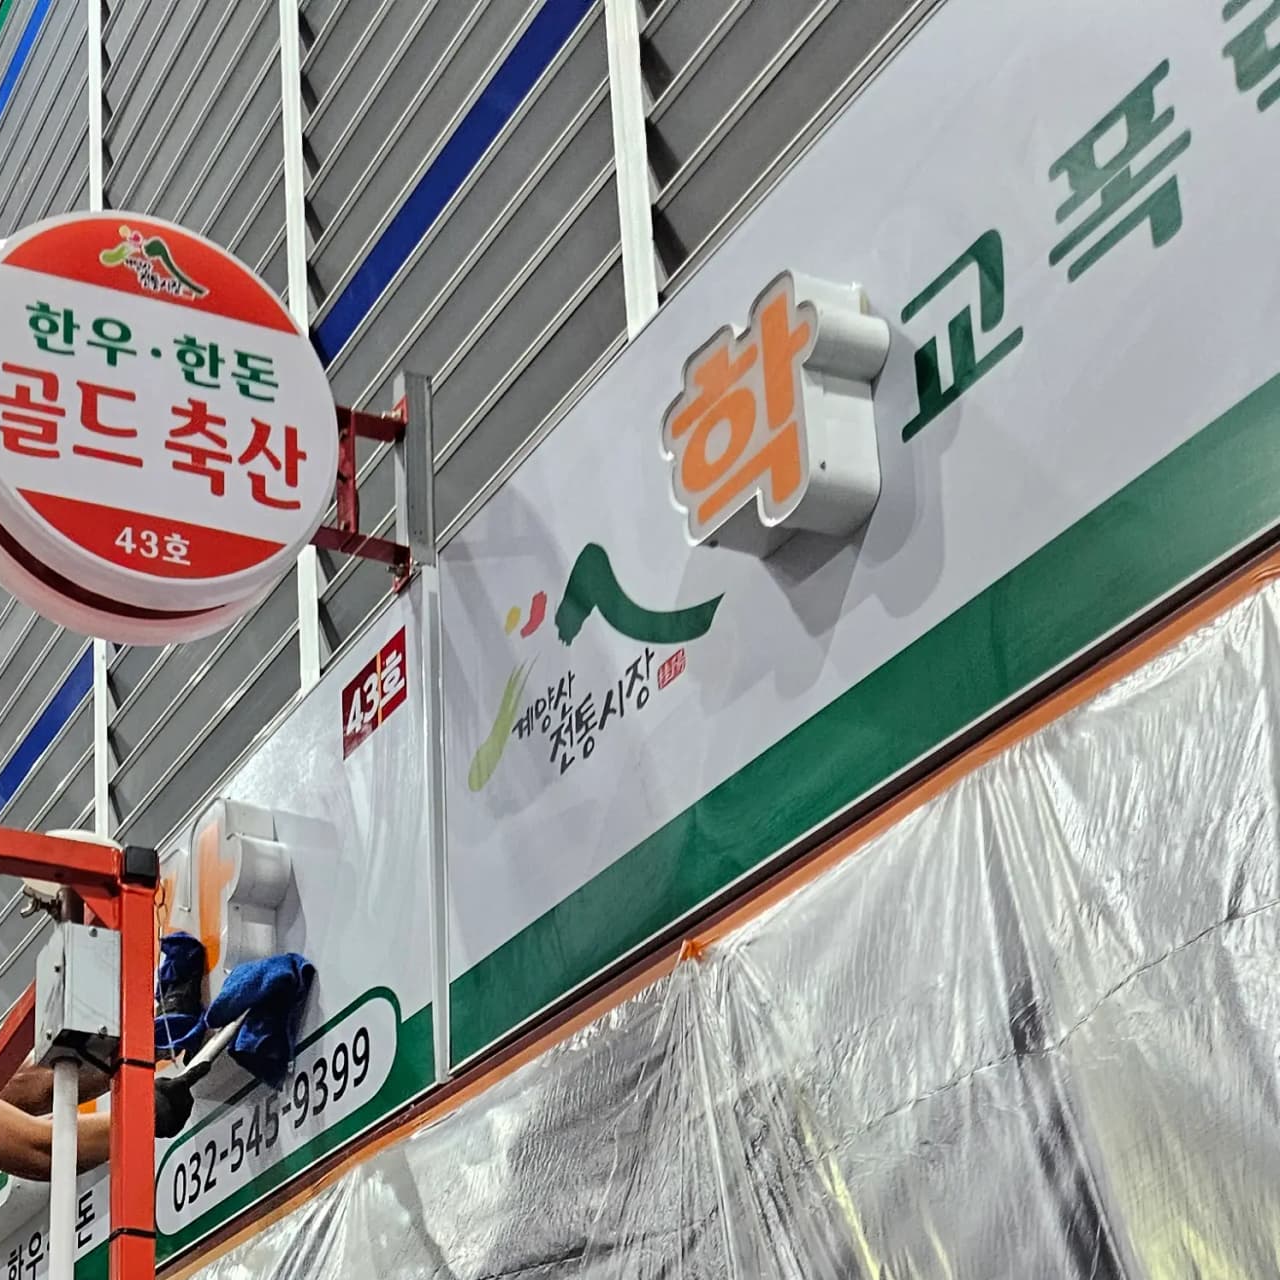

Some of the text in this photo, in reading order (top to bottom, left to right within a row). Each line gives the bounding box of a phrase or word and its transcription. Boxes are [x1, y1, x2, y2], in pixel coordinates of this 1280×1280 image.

[164, 398, 308, 511] 축산
[114, 526, 192, 567] 43호
[345, 649, 406, 736] 43호
[512, 670, 576, 739] 계양산
[550, 647, 655, 775] 전통시장
[173, 1026, 371, 1214] 032-545-9399
